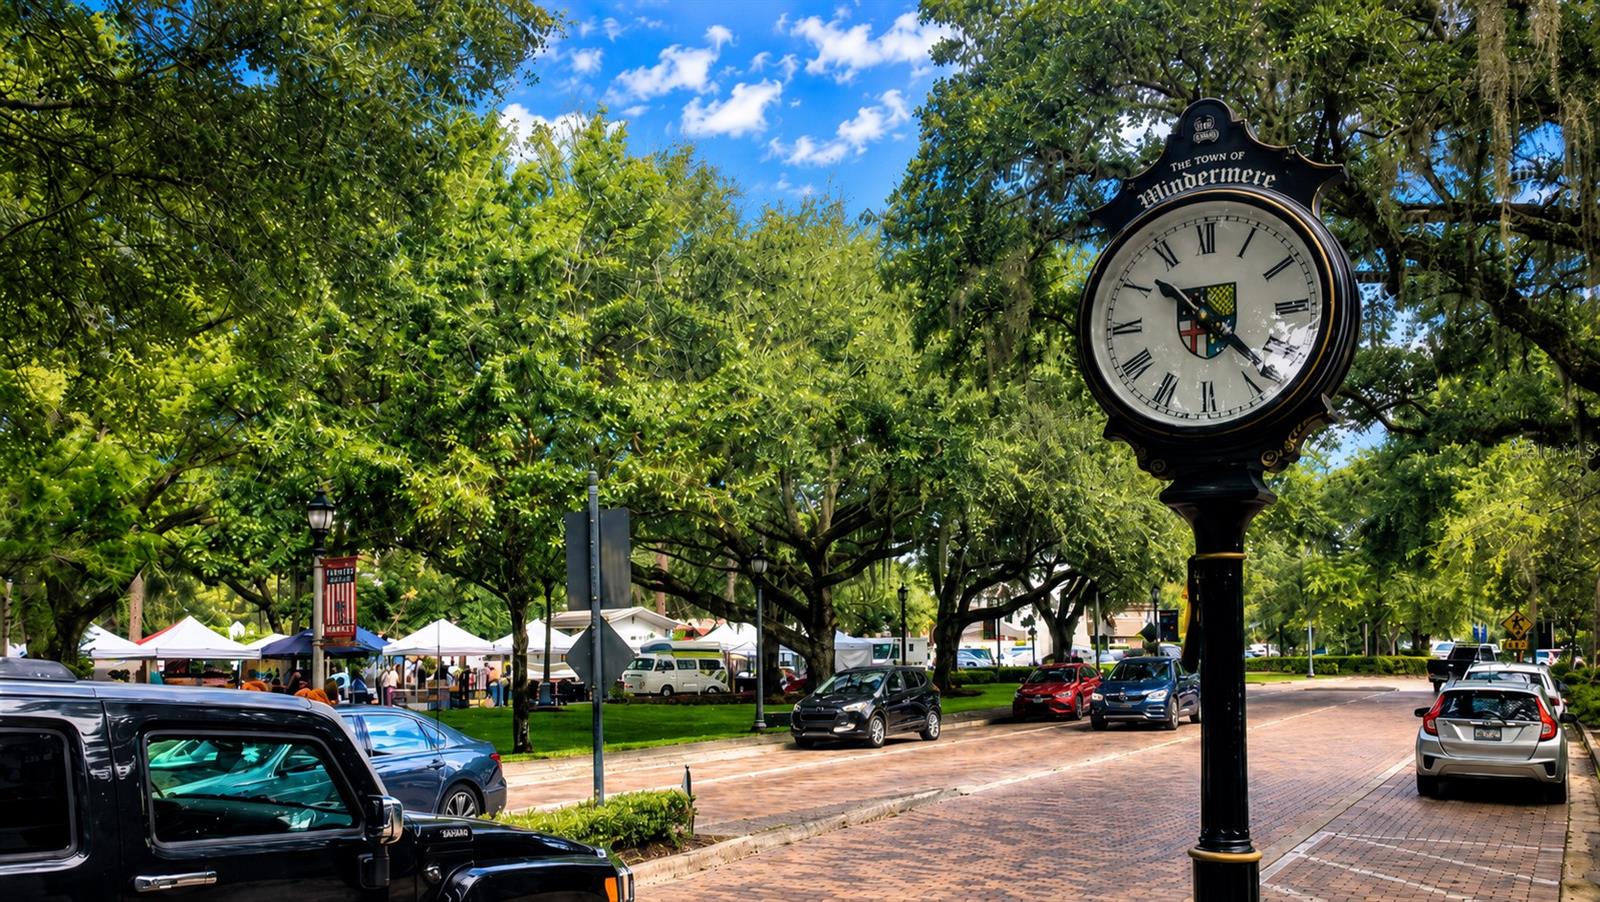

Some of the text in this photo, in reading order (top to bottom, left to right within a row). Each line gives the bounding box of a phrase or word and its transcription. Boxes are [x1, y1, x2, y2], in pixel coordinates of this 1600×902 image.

[1170, 151, 1245, 172] THE TOWN OF
[1137, 167, 1276, 208] Windermere
